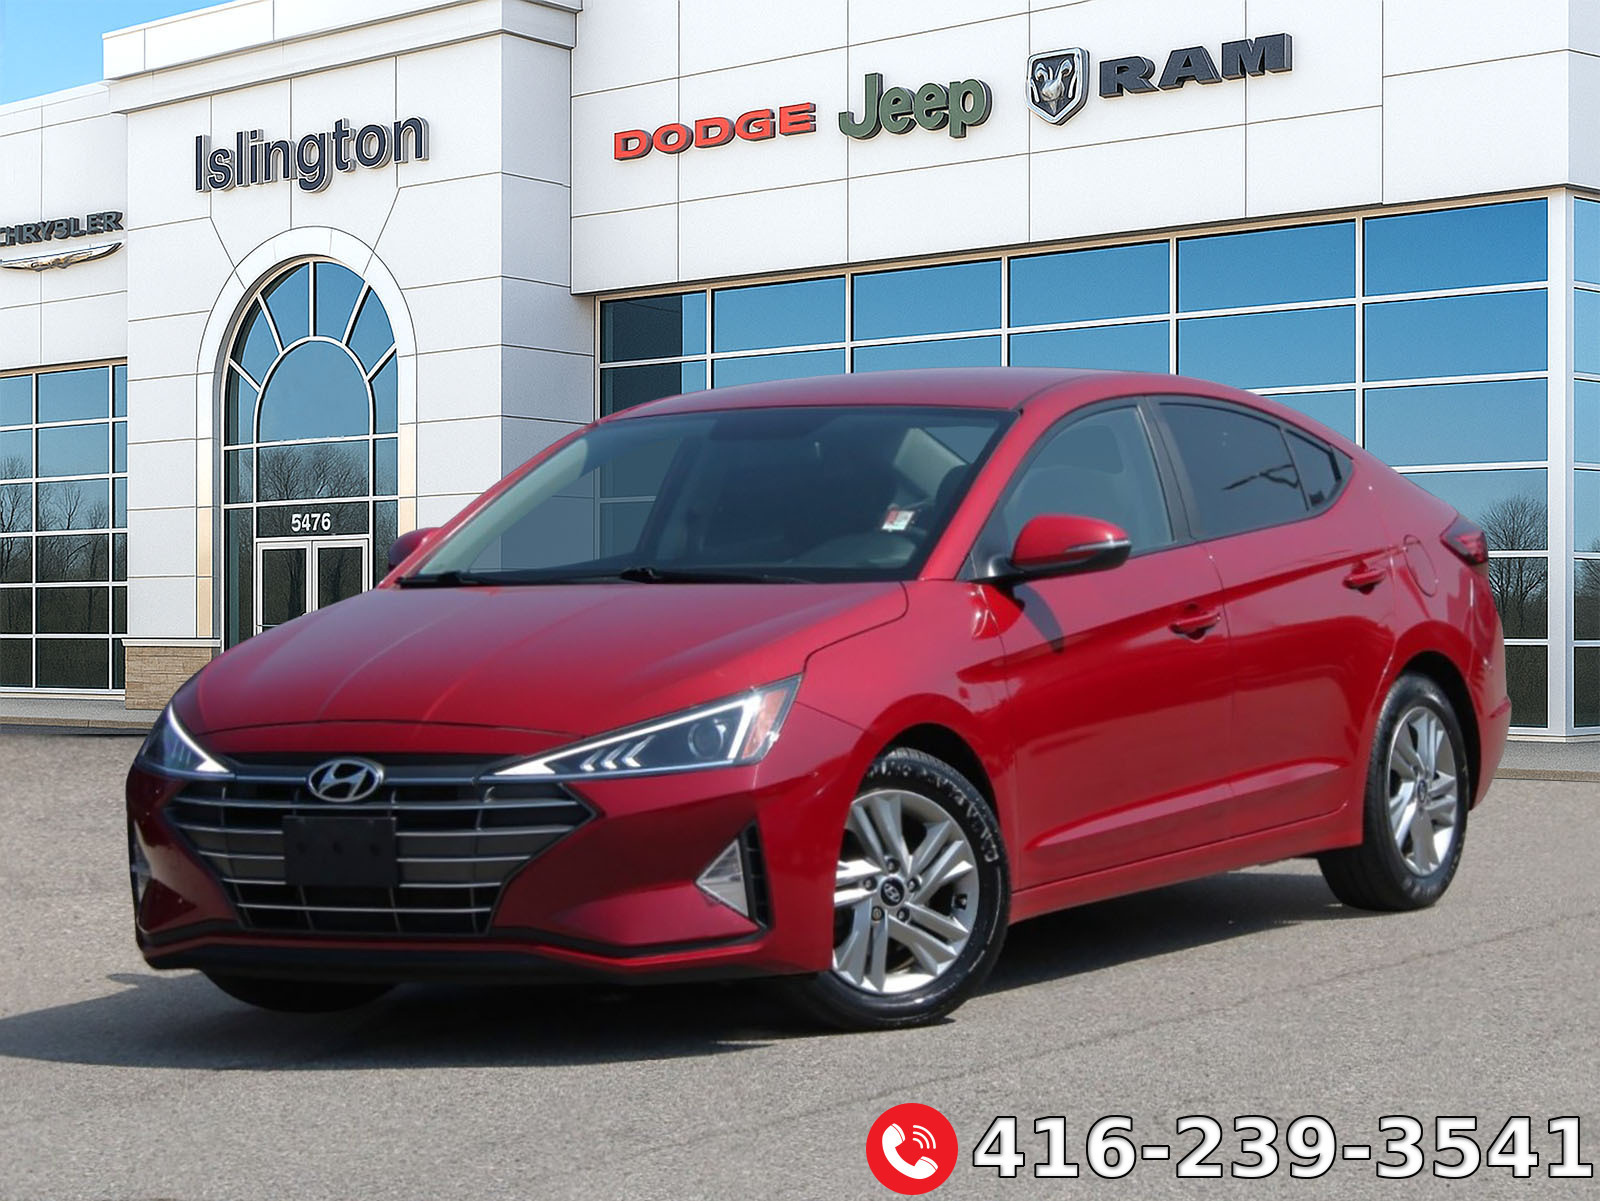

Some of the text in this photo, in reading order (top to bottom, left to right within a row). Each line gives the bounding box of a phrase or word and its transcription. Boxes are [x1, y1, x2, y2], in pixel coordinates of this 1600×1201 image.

[613, 33, 1292, 161] DODGE Jeep RAM
[195, 116, 430, 193] Islington
[291, 512, 331, 532] 5476
